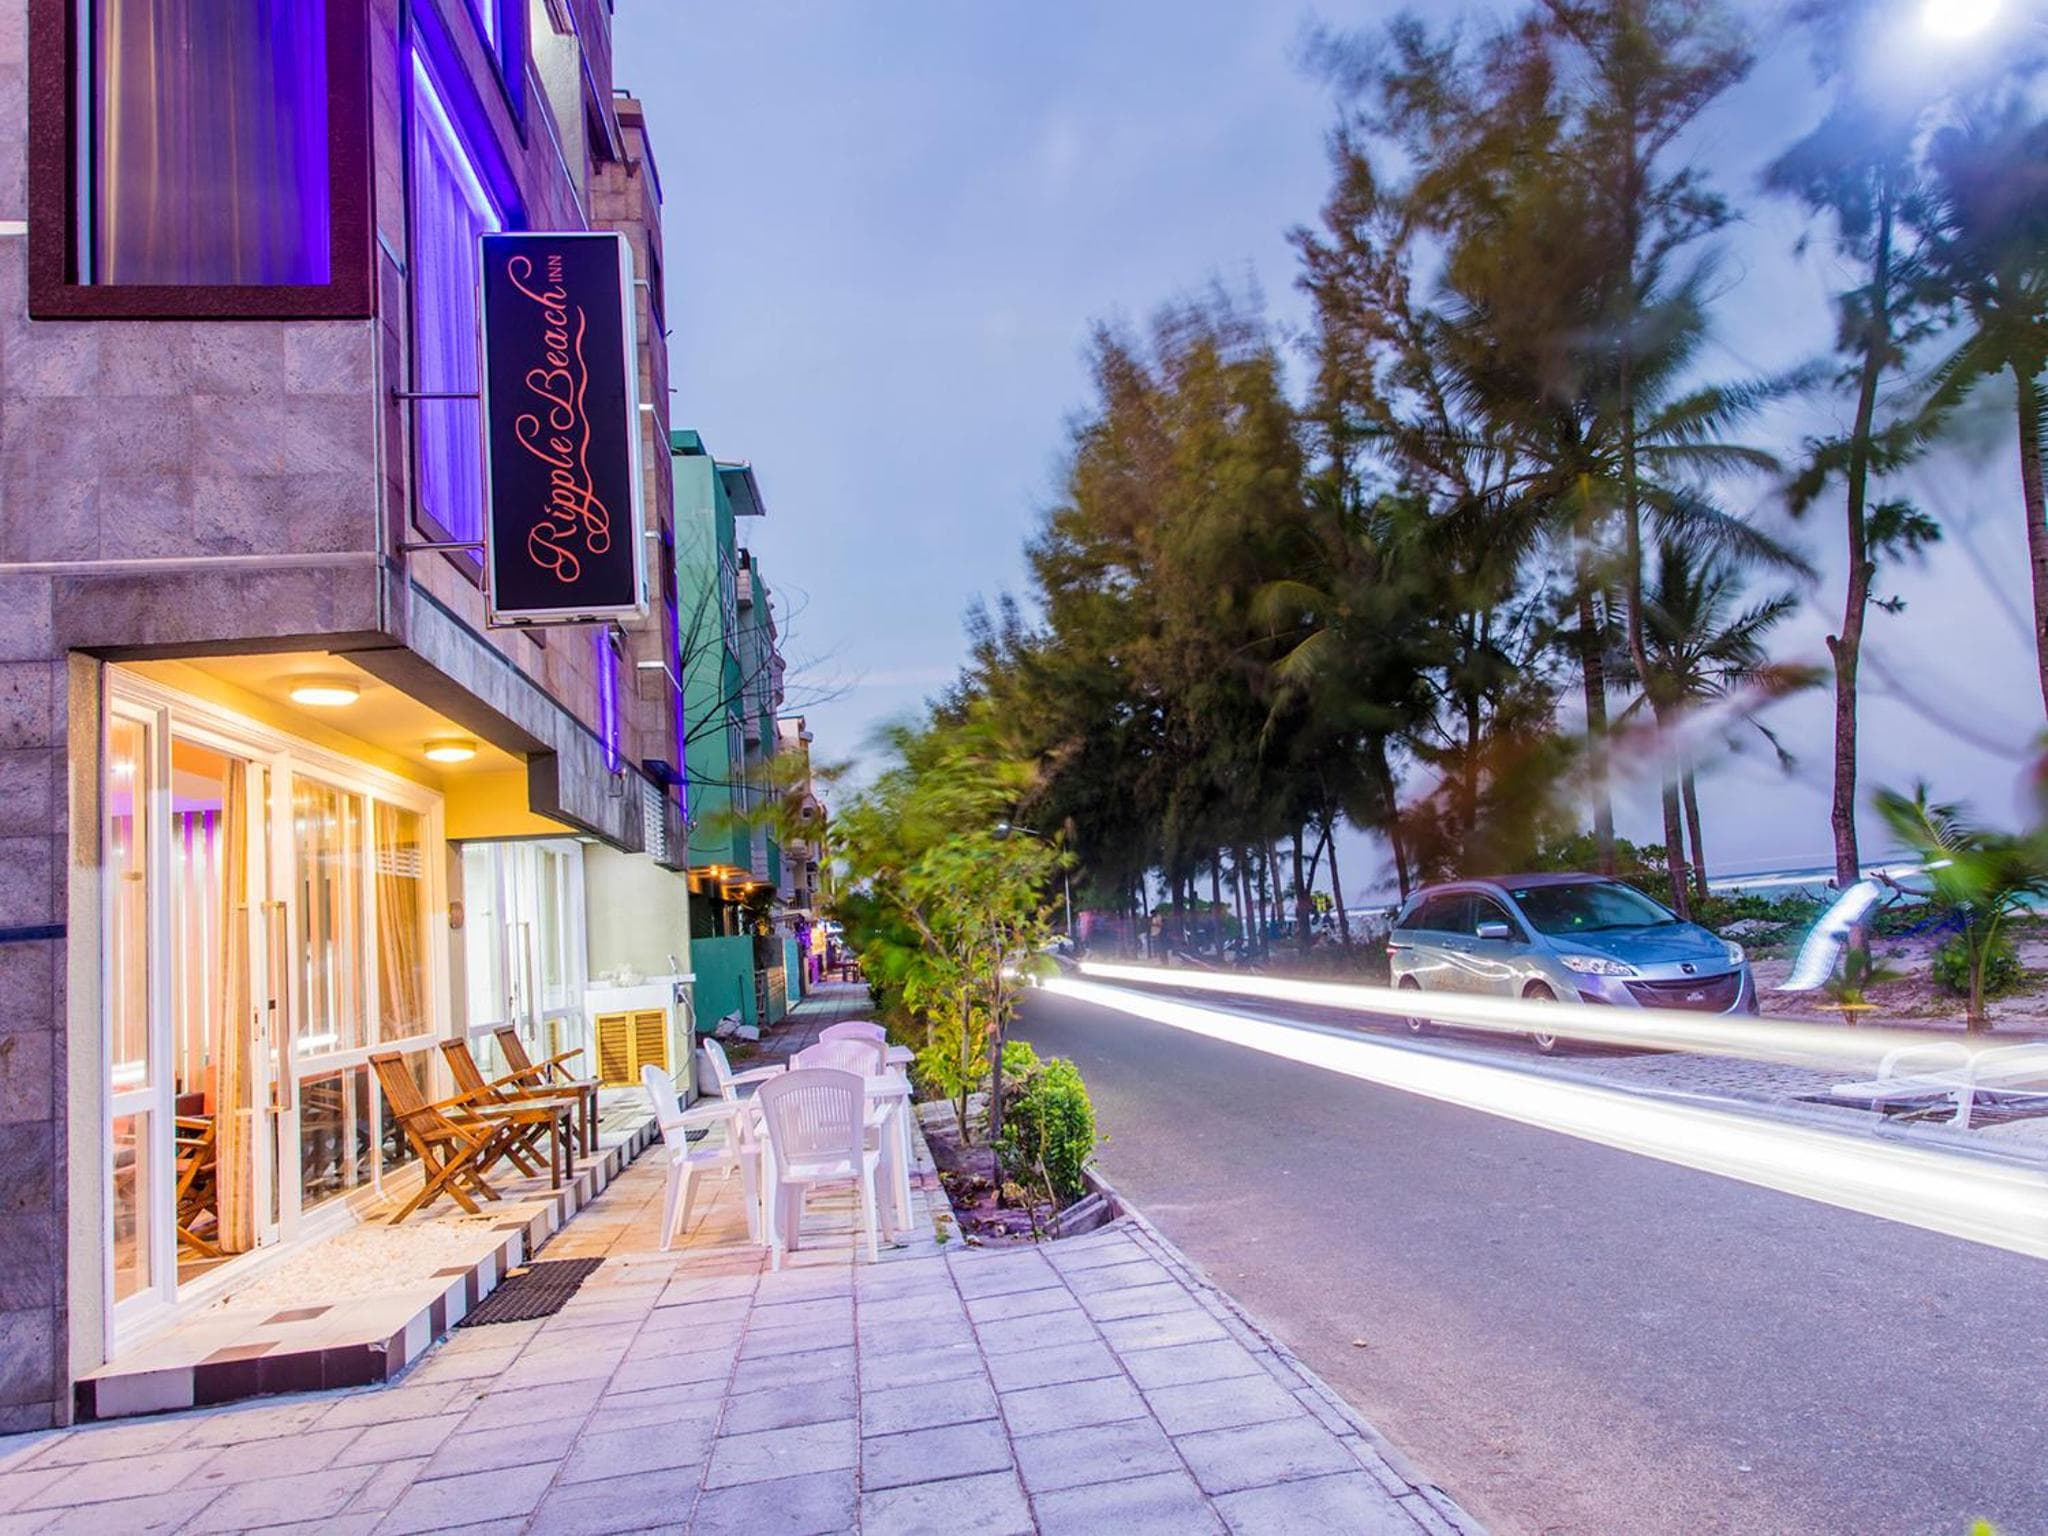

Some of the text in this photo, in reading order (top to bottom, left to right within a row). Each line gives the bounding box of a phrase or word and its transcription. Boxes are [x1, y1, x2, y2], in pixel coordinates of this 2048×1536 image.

[507, 253, 610, 583] Ripple Beach INN
